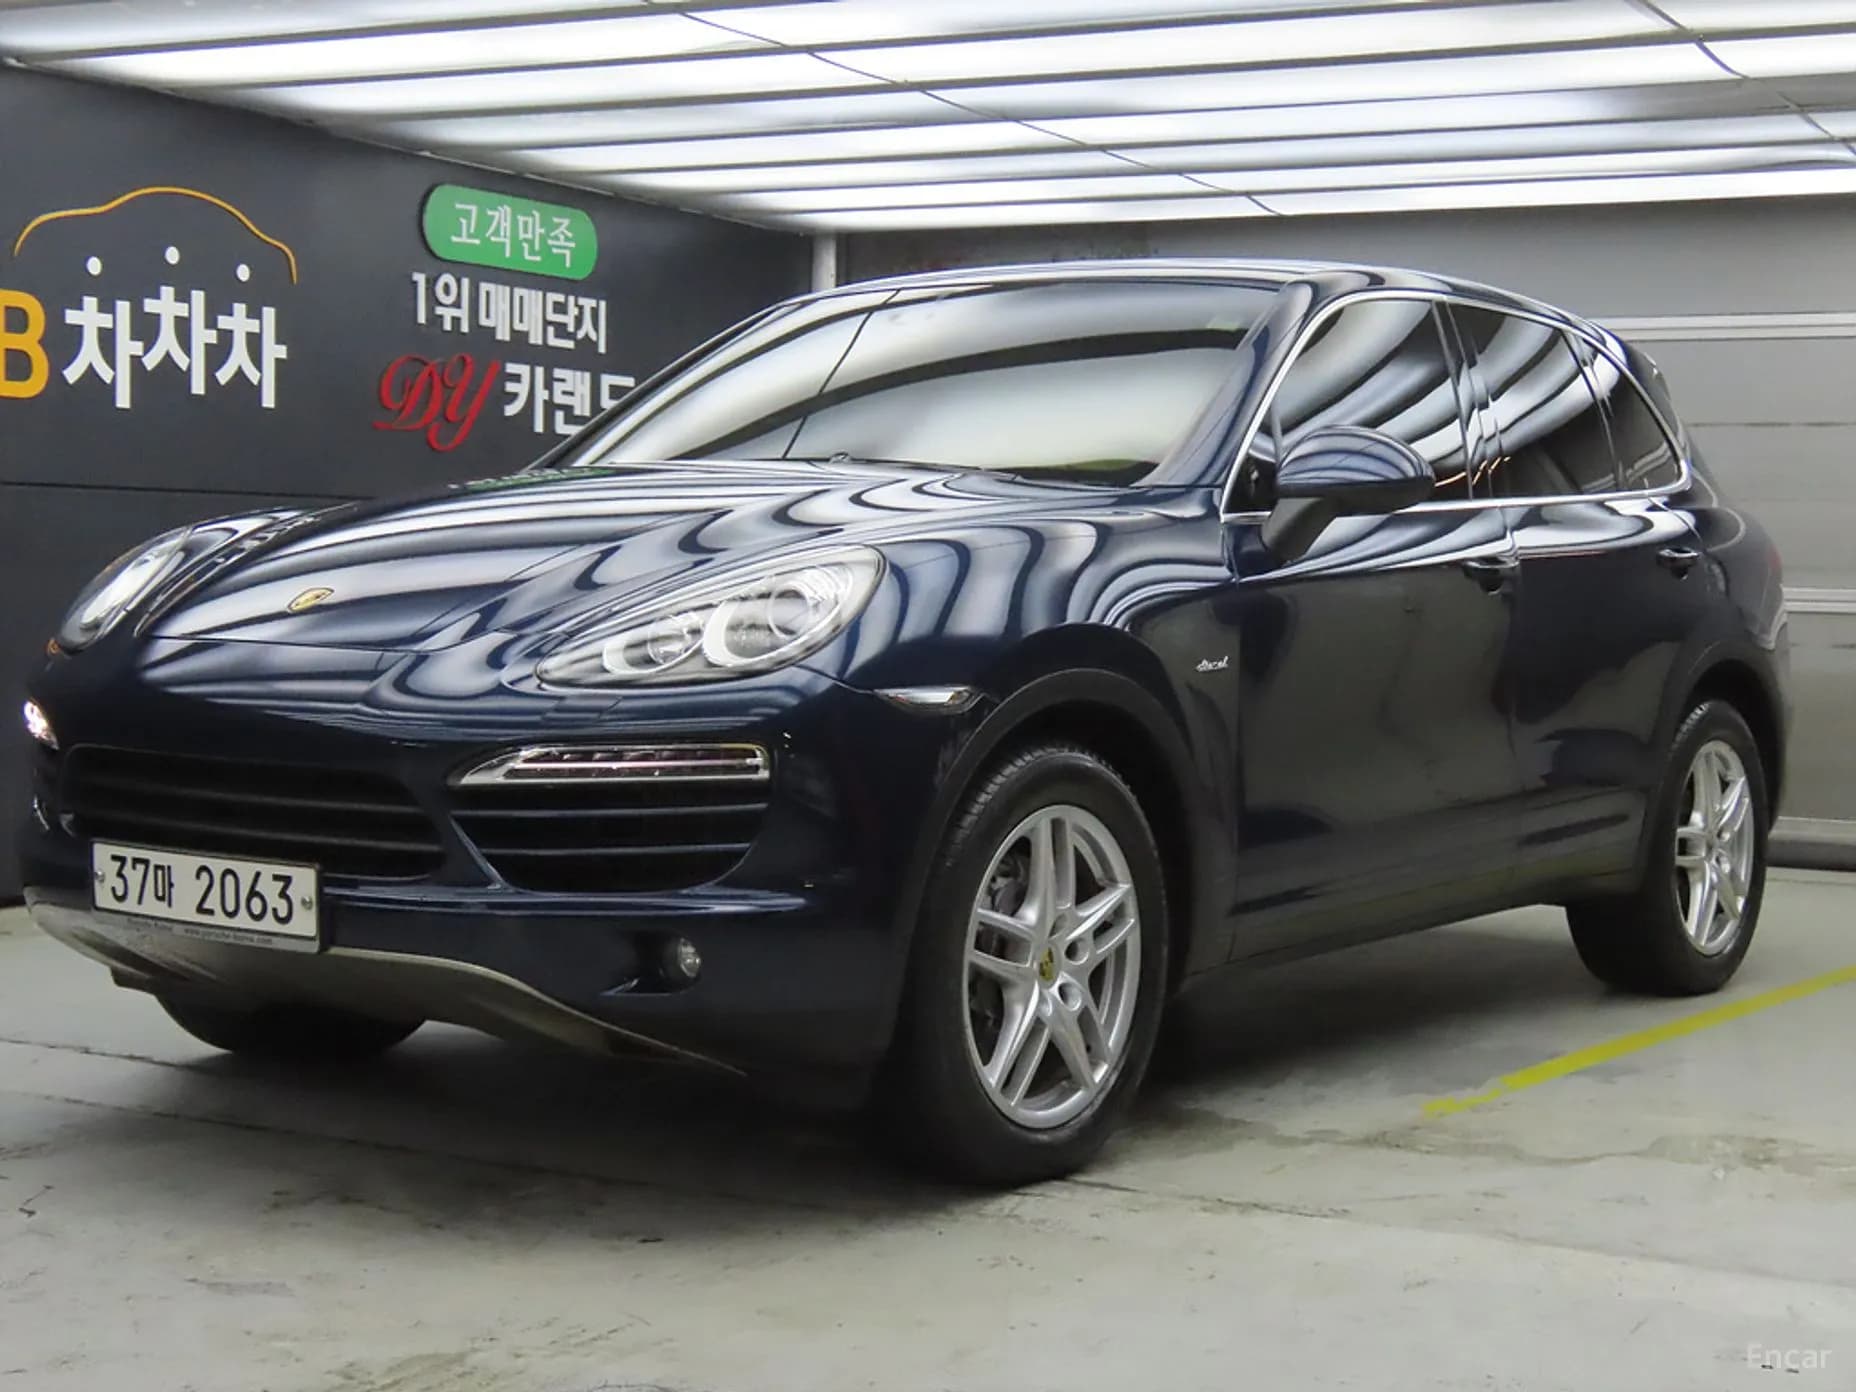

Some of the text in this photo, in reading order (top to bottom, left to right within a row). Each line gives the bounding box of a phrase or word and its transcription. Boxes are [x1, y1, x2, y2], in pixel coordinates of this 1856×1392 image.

[451, 203, 576, 268] 고객만족
[63, 286, 288, 409] 차차차
[412, 272, 606, 354] 1위 매매단지
[373, 353, 500, 452] DY
[110, 854, 294, 925] 37마 2063
